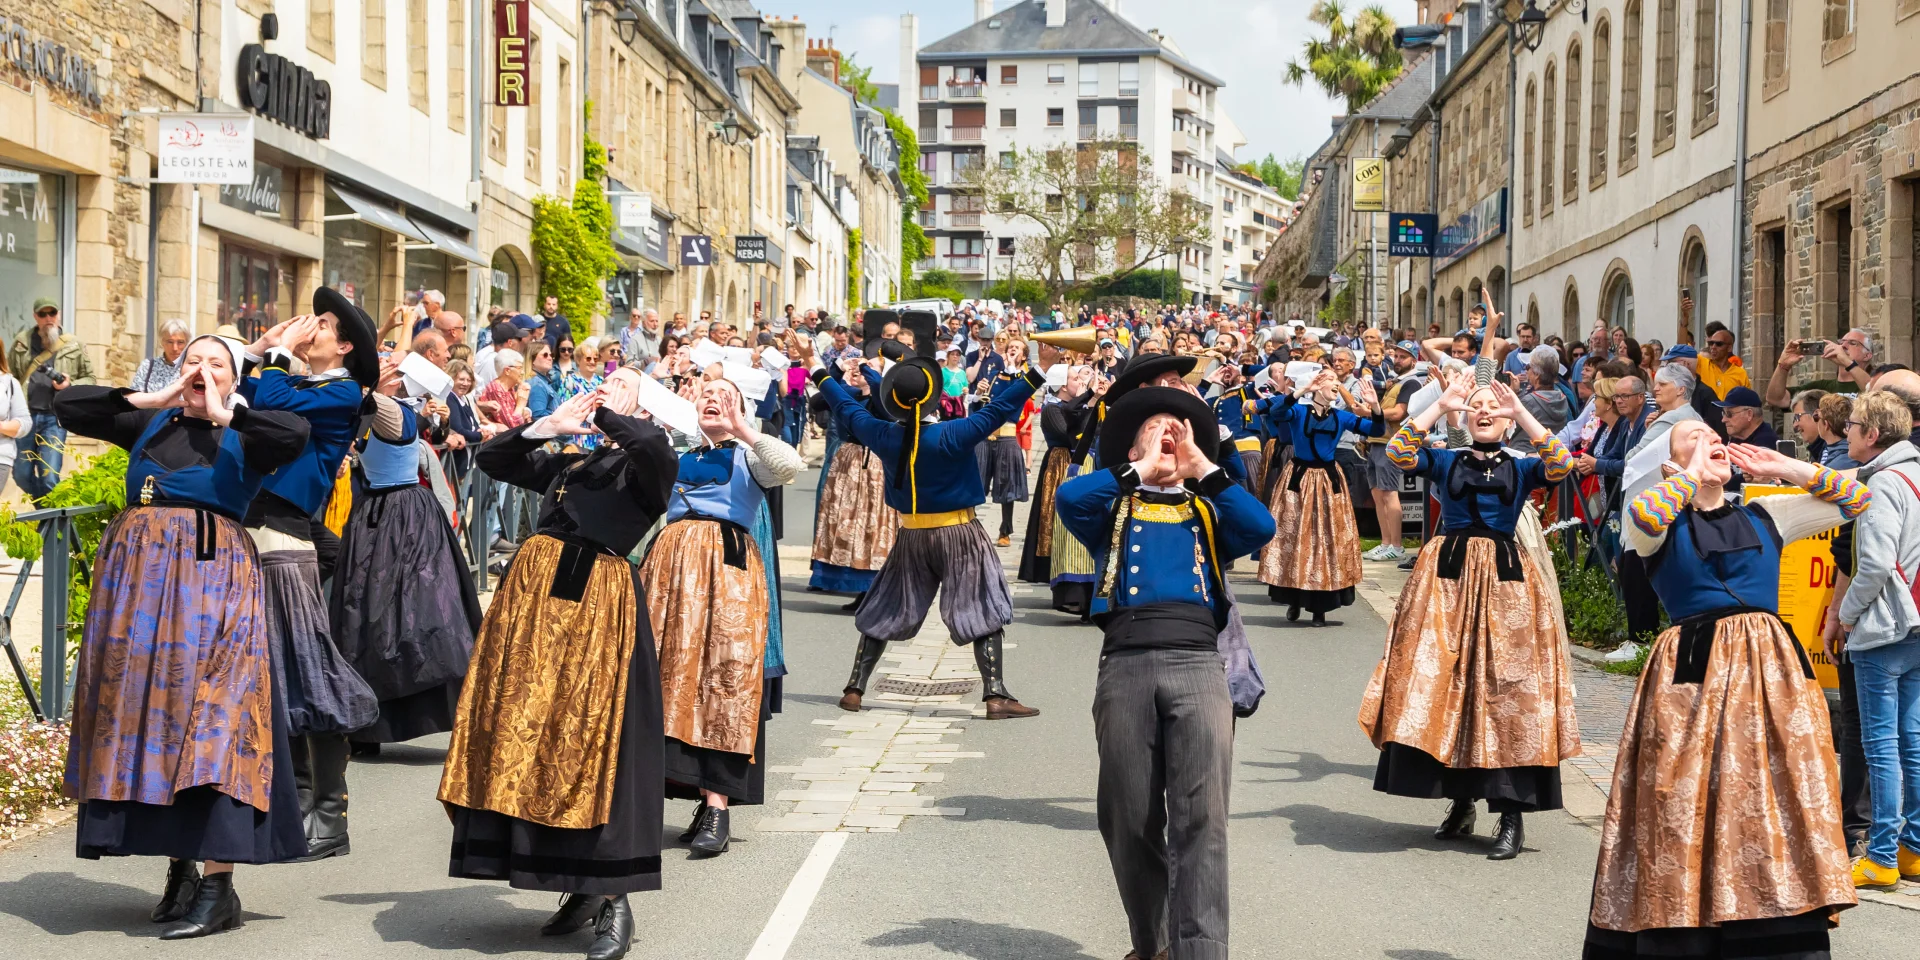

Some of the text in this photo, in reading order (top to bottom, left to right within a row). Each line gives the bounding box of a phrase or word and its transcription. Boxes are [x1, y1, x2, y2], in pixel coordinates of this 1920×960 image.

[236, 13, 331, 140] cinna
[162, 156, 249, 168] LEGISTEAM
[1355, 163, 1381, 182] COPY
[736, 249, 765, 260] KEBAB
[1391, 245, 1429, 254] FONCIA
